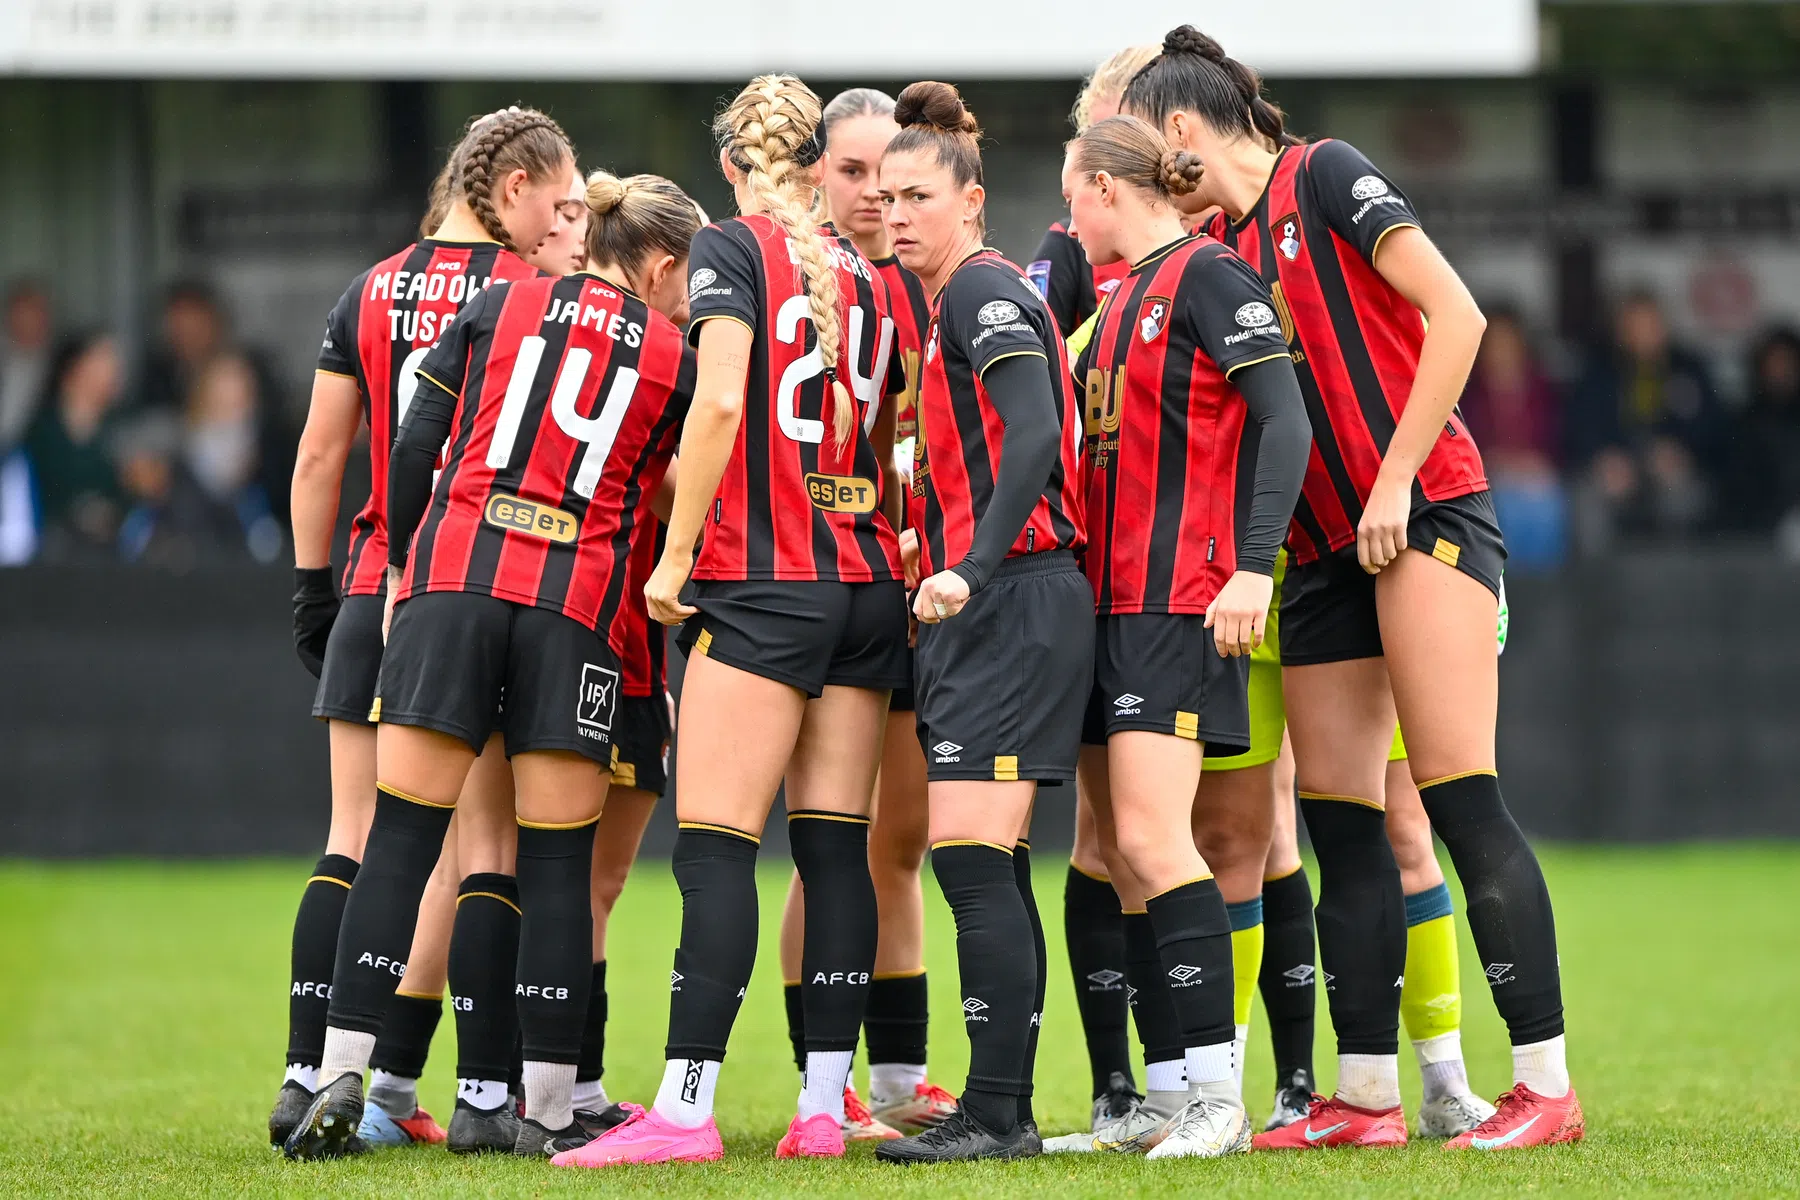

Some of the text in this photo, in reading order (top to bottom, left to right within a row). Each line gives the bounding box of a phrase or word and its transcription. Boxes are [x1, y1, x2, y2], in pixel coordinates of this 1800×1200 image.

[436, 262, 461, 270] AFCB
[370, 271, 508, 304] MEADOW
[590, 288, 617, 299] AFCB
[544, 298, 644, 348] JAMES
[776, 295, 895, 444] 24
[485, 335, 641, 499] 14
[586, 680, 611, 719] IFX
[1115, 708, 1141, 716] umbro
[577, 725, 609, 744] PAYMENTS
[935, 756, 960, 764] umbro
[812, 972, 869, 985] AFCB
[1171, 979, 1202, 988] umbro
[515, 983, 569, 1001] AFCB
[683, 1059, 702, 1103] FOX
